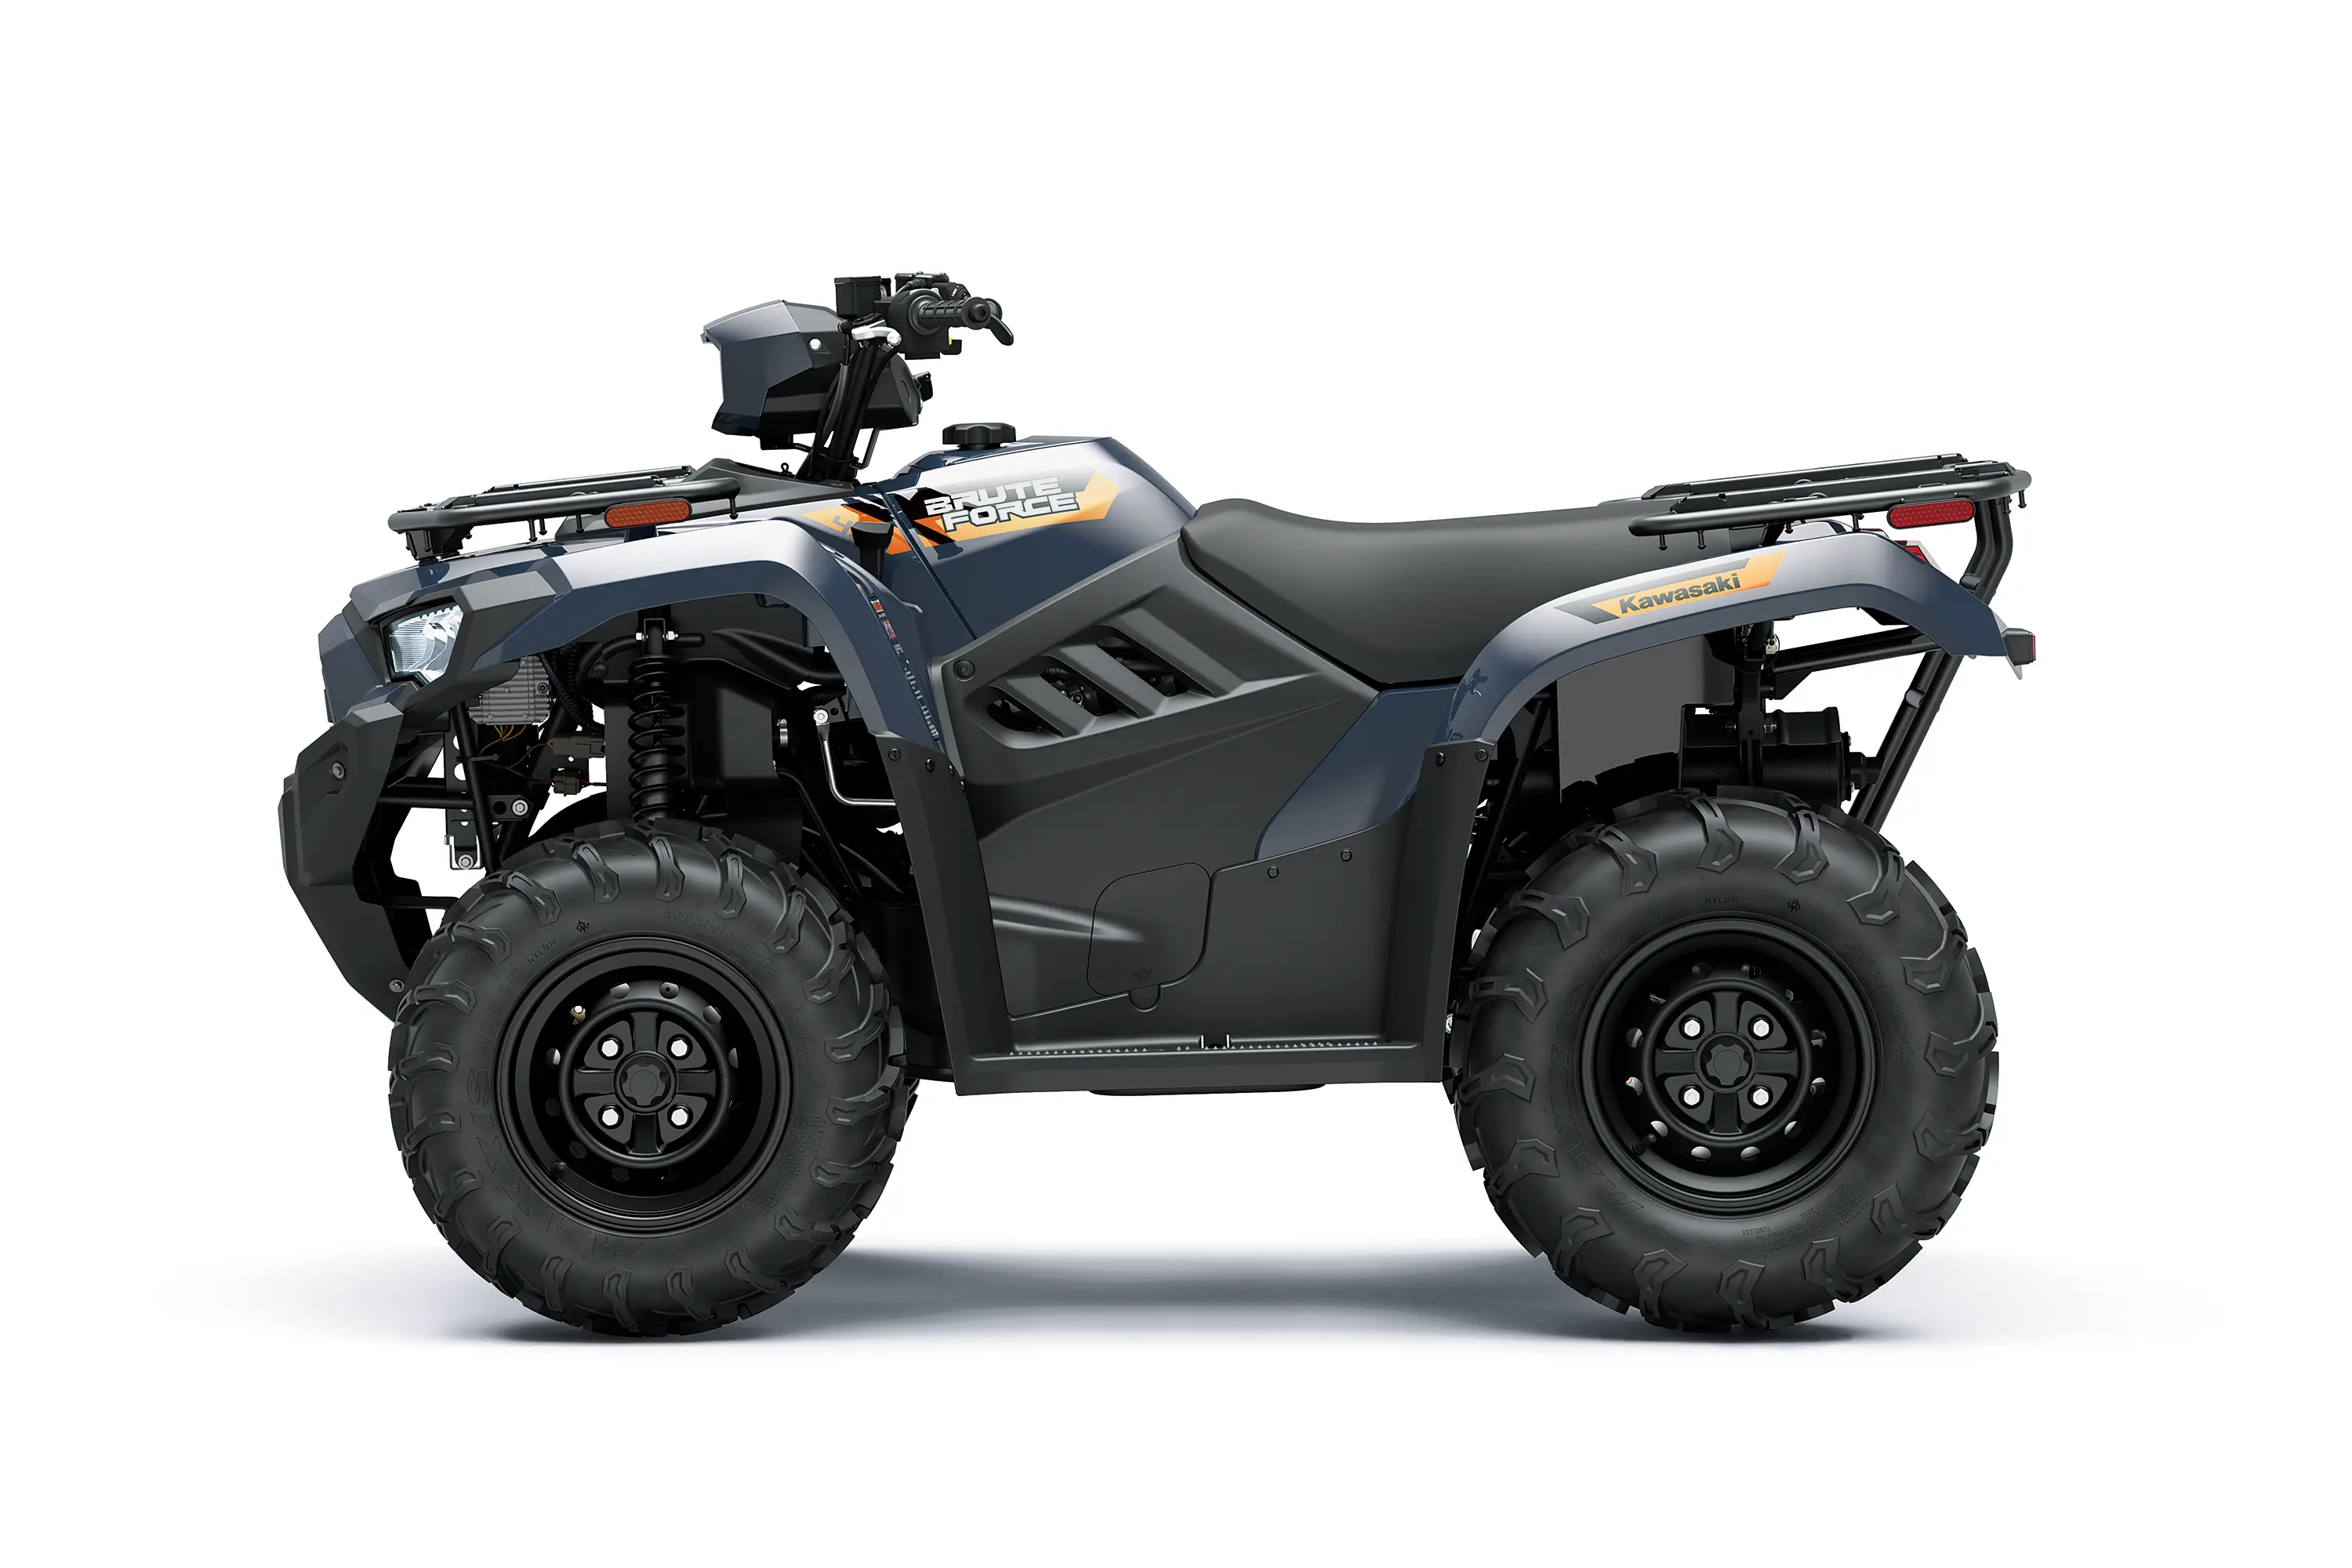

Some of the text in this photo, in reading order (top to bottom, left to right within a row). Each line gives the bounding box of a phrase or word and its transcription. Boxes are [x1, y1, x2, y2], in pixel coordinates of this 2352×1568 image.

[924, 477, 1062, 517] BRUTE
[940, 492, 1080, 532] FORCE
[1619, 573, 1741, 614] Kawasaki
[1704, 895, 1739, 905] NYLON
[526, 938, 557, 964] NYLON
[1548, 981, 1645, 1214] MAXXIS
[466, 1066, 645, 1261] MAXXIS
[1740, 1225, 1772, 1237] TUBELESS
